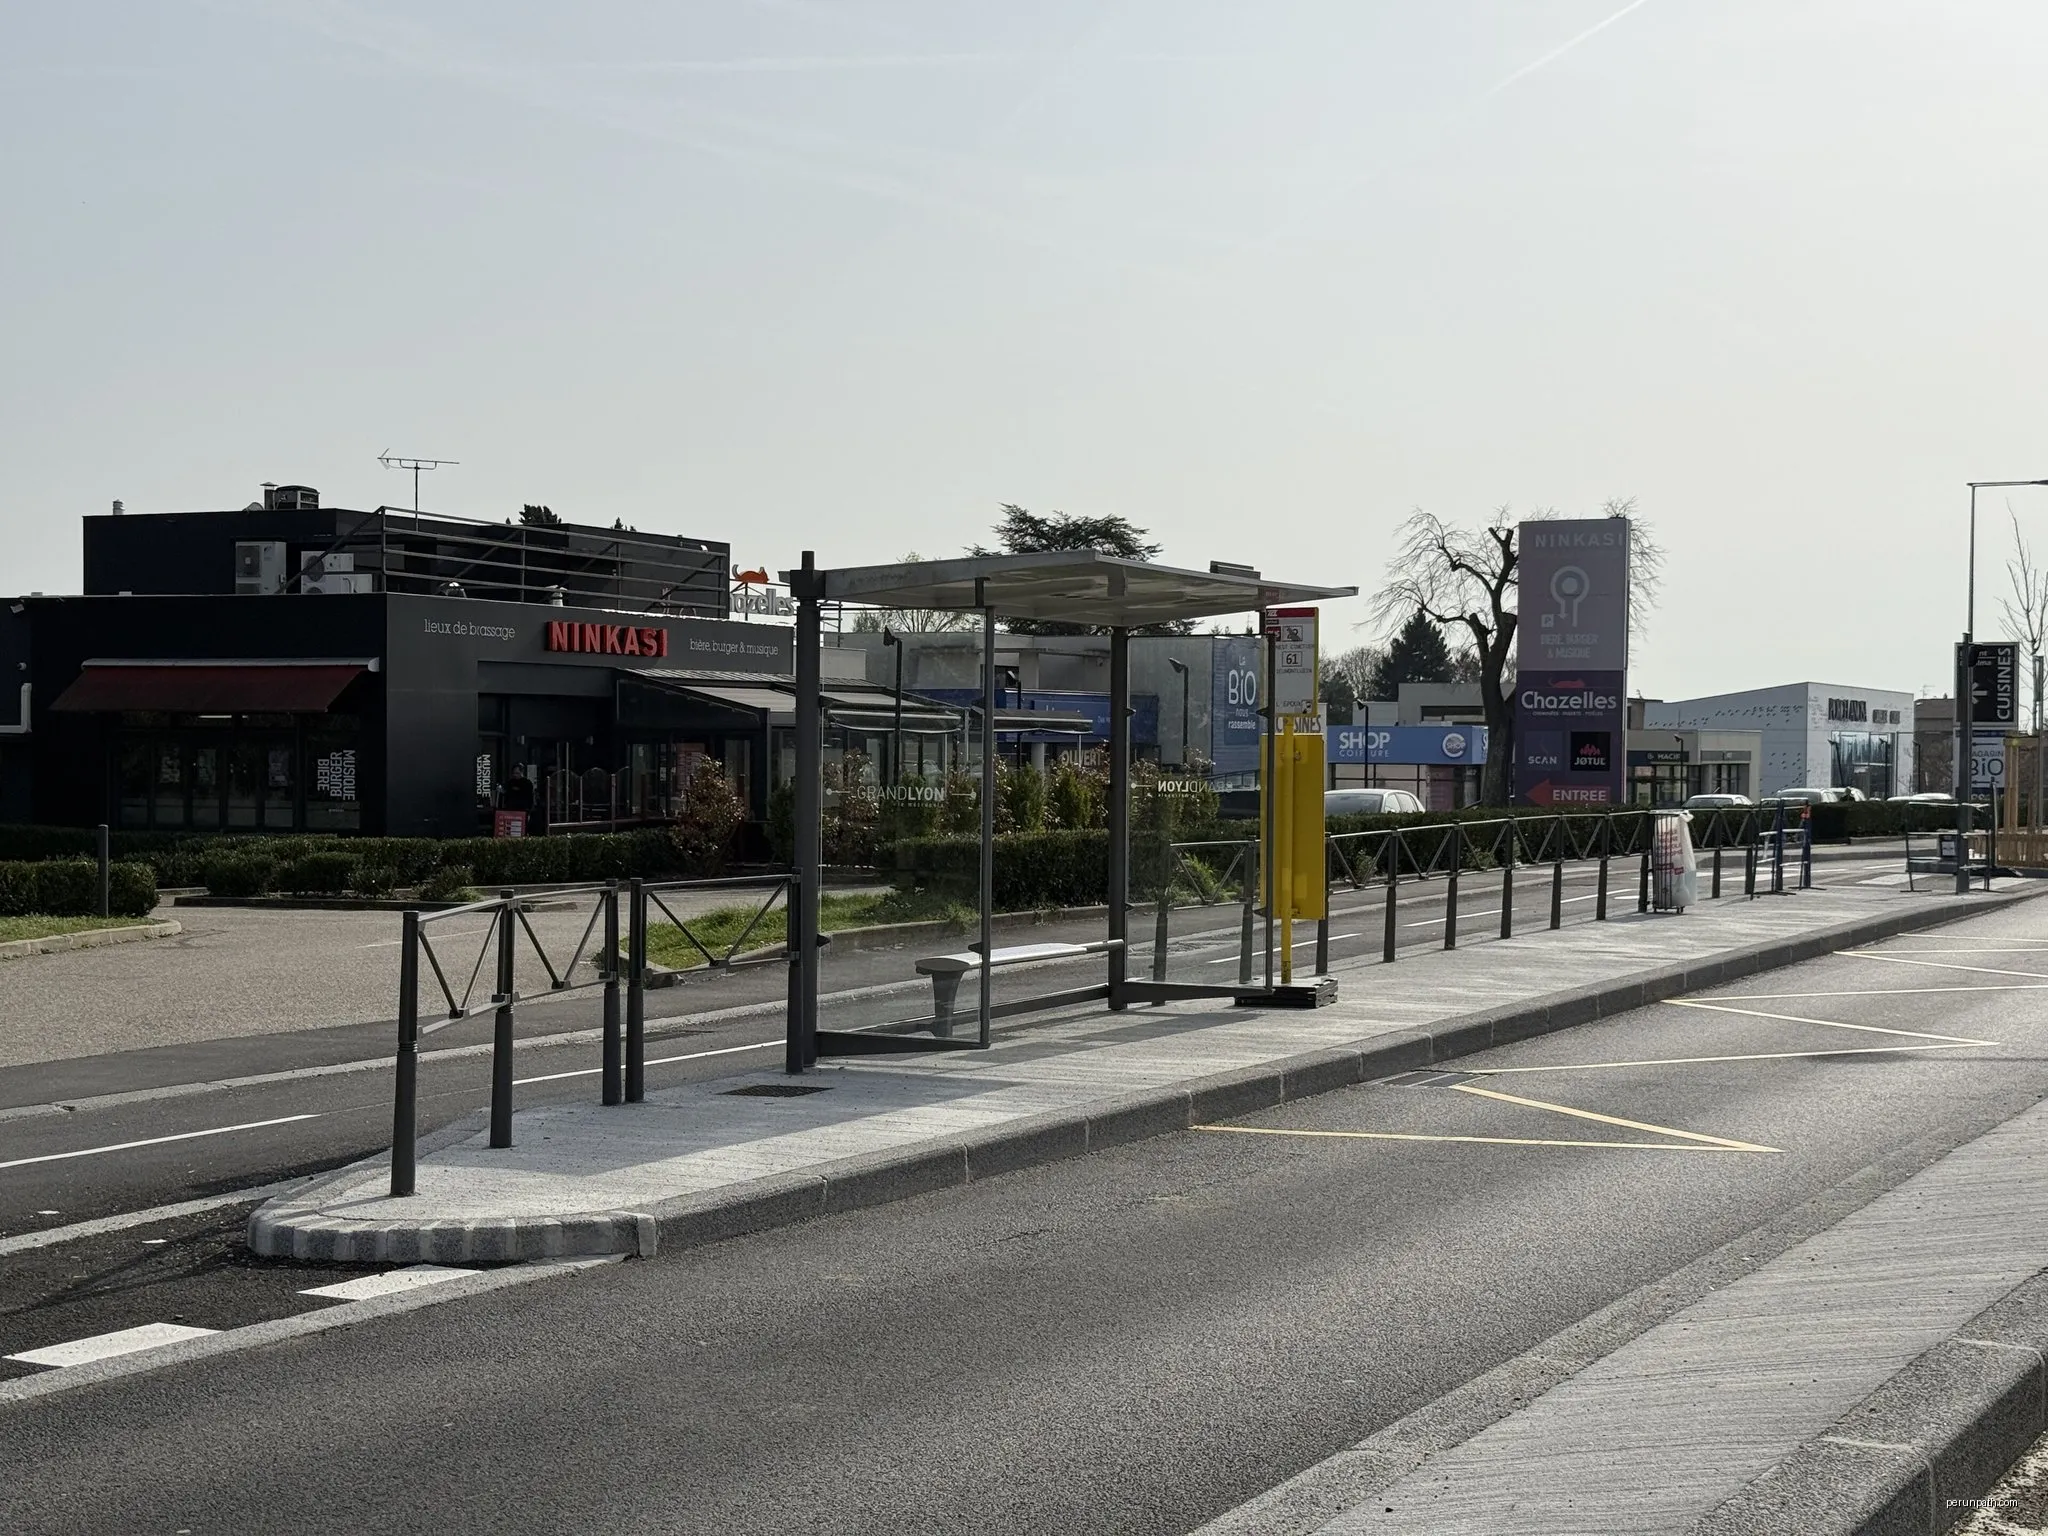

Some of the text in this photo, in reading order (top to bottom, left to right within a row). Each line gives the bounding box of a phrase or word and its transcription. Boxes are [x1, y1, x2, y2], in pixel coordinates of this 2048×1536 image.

[1535, 533, 1623, 548] NINKASI
[731, 588, 795, 616] azelles
[424, 618, 516, 641] lieux de brassage
[548, 621, 668, 657] NINKASI
[713, 640, 738, 655] burger
[739, 641, 746, 653] &
[747, 644, 779, 658] musique
[1286, 653, 1299, 665] 61
[1997, 647, 2011, 720] CUISINES
[1521, 691, 1617, 710] Chazelles
[1228, 719, 1256, 730] rassemble
[1276, 714, 1322, 734] CSINES
[1339, 731, 1391, 750] SHOP
[1060, 749, 1102, 767] OUVERT
[1339, 749, 1391, 758] COIFURE
[1527, 756, 1558, 765] SCAN
[316, 758, 330, 792] BIERE
[330, 751, 343, 798] BURGER
[342, 749, 356, 801] MUSIQUE
[482, 754, 492, 798] MUSIQUE
[857, 785, 945, 802] GRANDLYON
[1552, 788, 1608, 801] ENTREE
